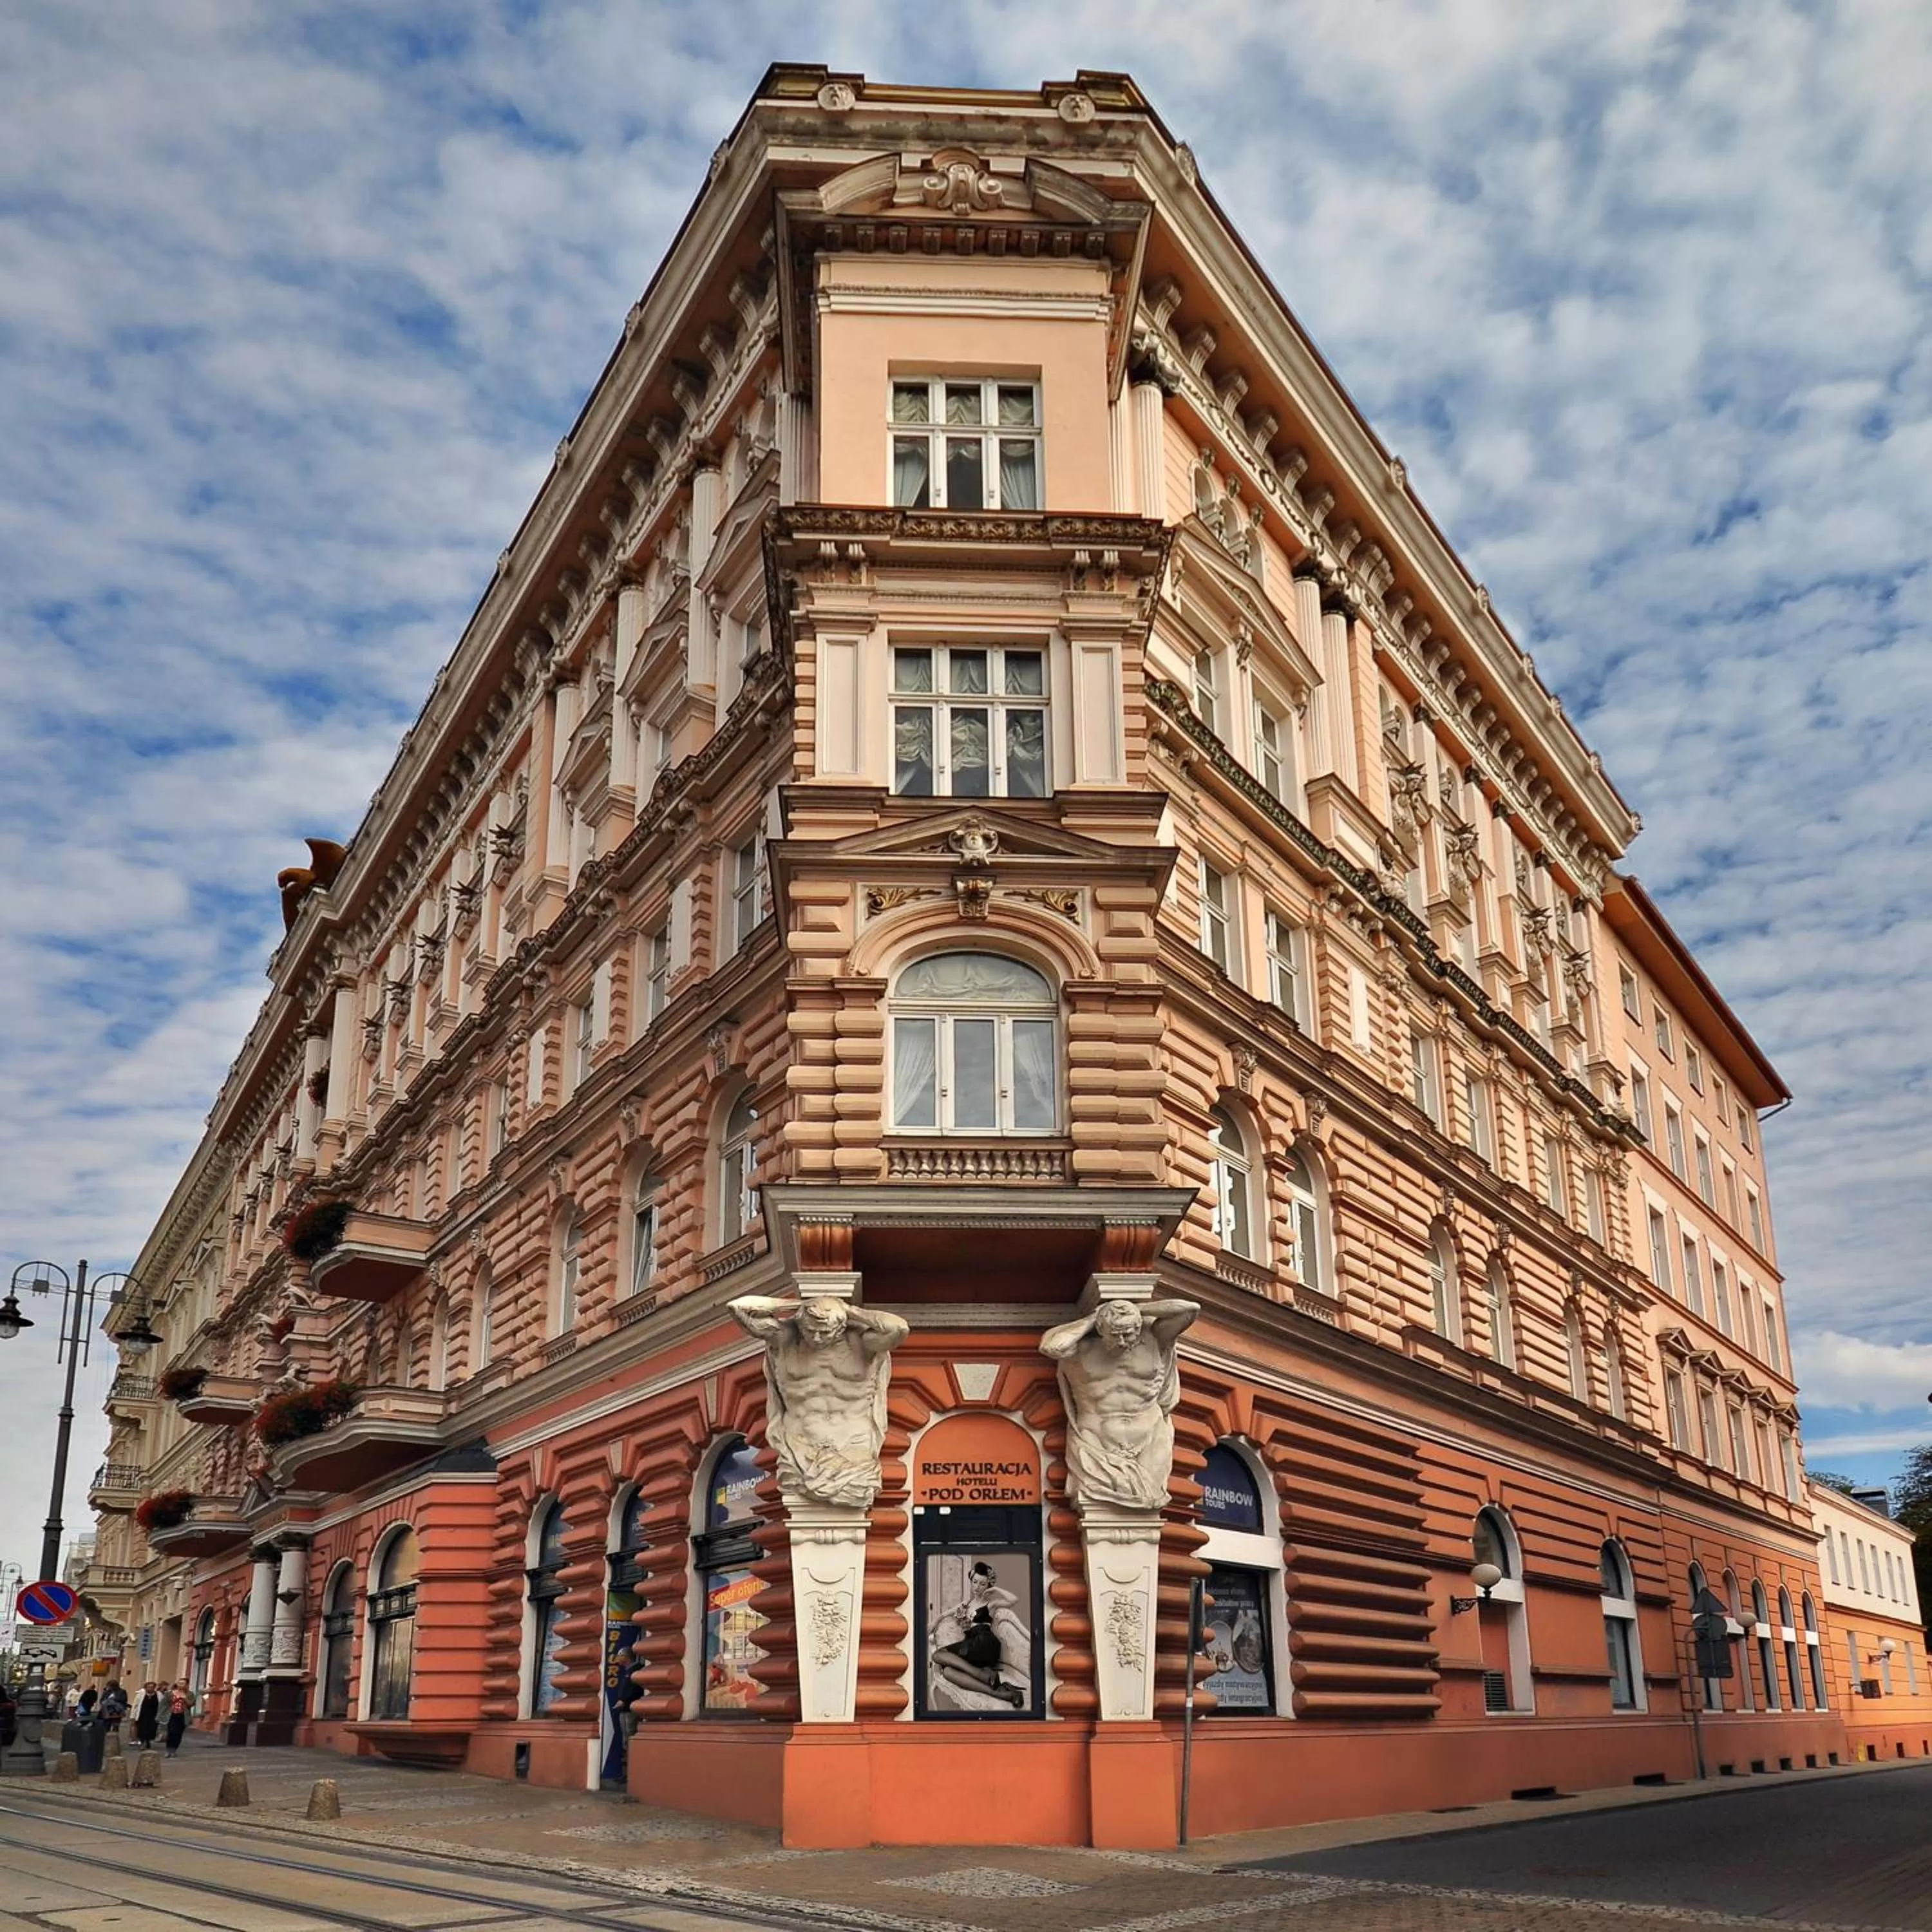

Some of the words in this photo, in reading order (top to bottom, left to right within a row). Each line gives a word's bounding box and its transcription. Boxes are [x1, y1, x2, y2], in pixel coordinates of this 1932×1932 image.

[922, 1463, 1032, 1476] RESTAURACJA
[956, 1477, 998, 1486] HOTELU
[929, 1488, 964, 1501] POD
[969, 1488, 1025, 1501] ORŁEM
[1205, 1485, 1253, 1507] RAINBOW
[1205, 1499, 1226, 1510] TOURS
[710, 1589, 735, 1607] Super
[608, 1630, 621, 1687] BIURO
